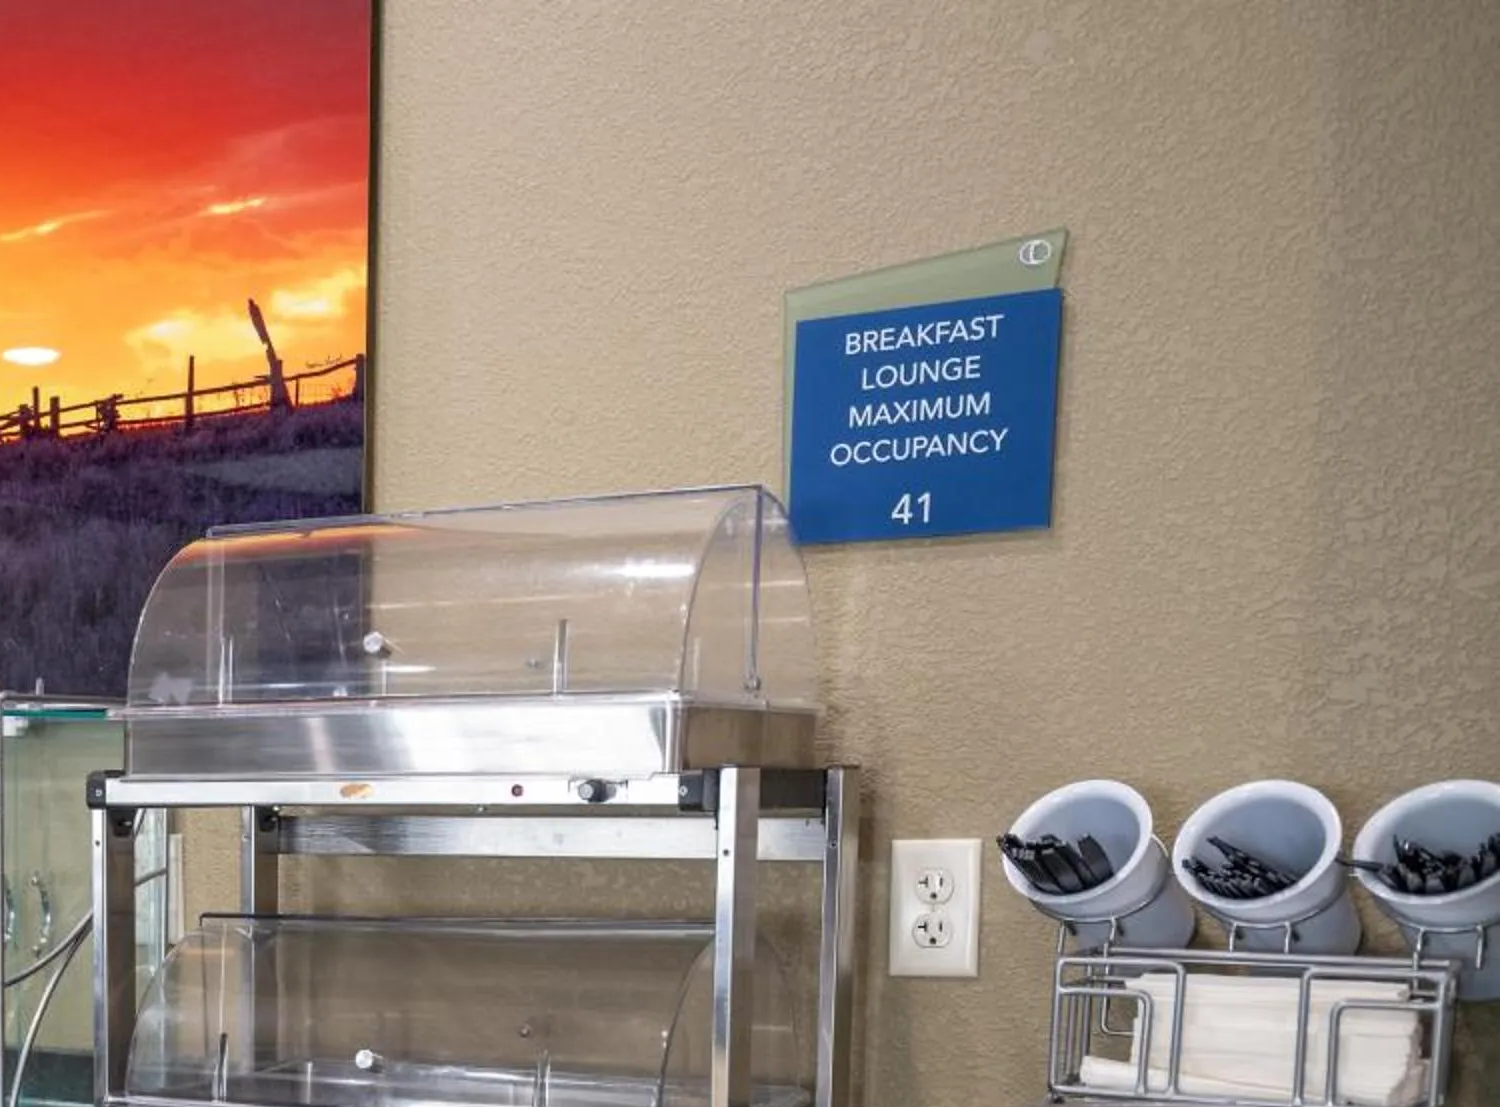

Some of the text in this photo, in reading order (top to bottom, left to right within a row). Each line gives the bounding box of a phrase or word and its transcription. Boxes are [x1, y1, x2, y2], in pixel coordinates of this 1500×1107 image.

[845, 314, 1004, 355] BREAKFAST
[861, 355, 981, 390] LOUNGE
[849, 391, 991, 428] MAXIMUM
[829, 428, 1008, 466] OCCUPANCY
[891, 492, 931, 525] 41
